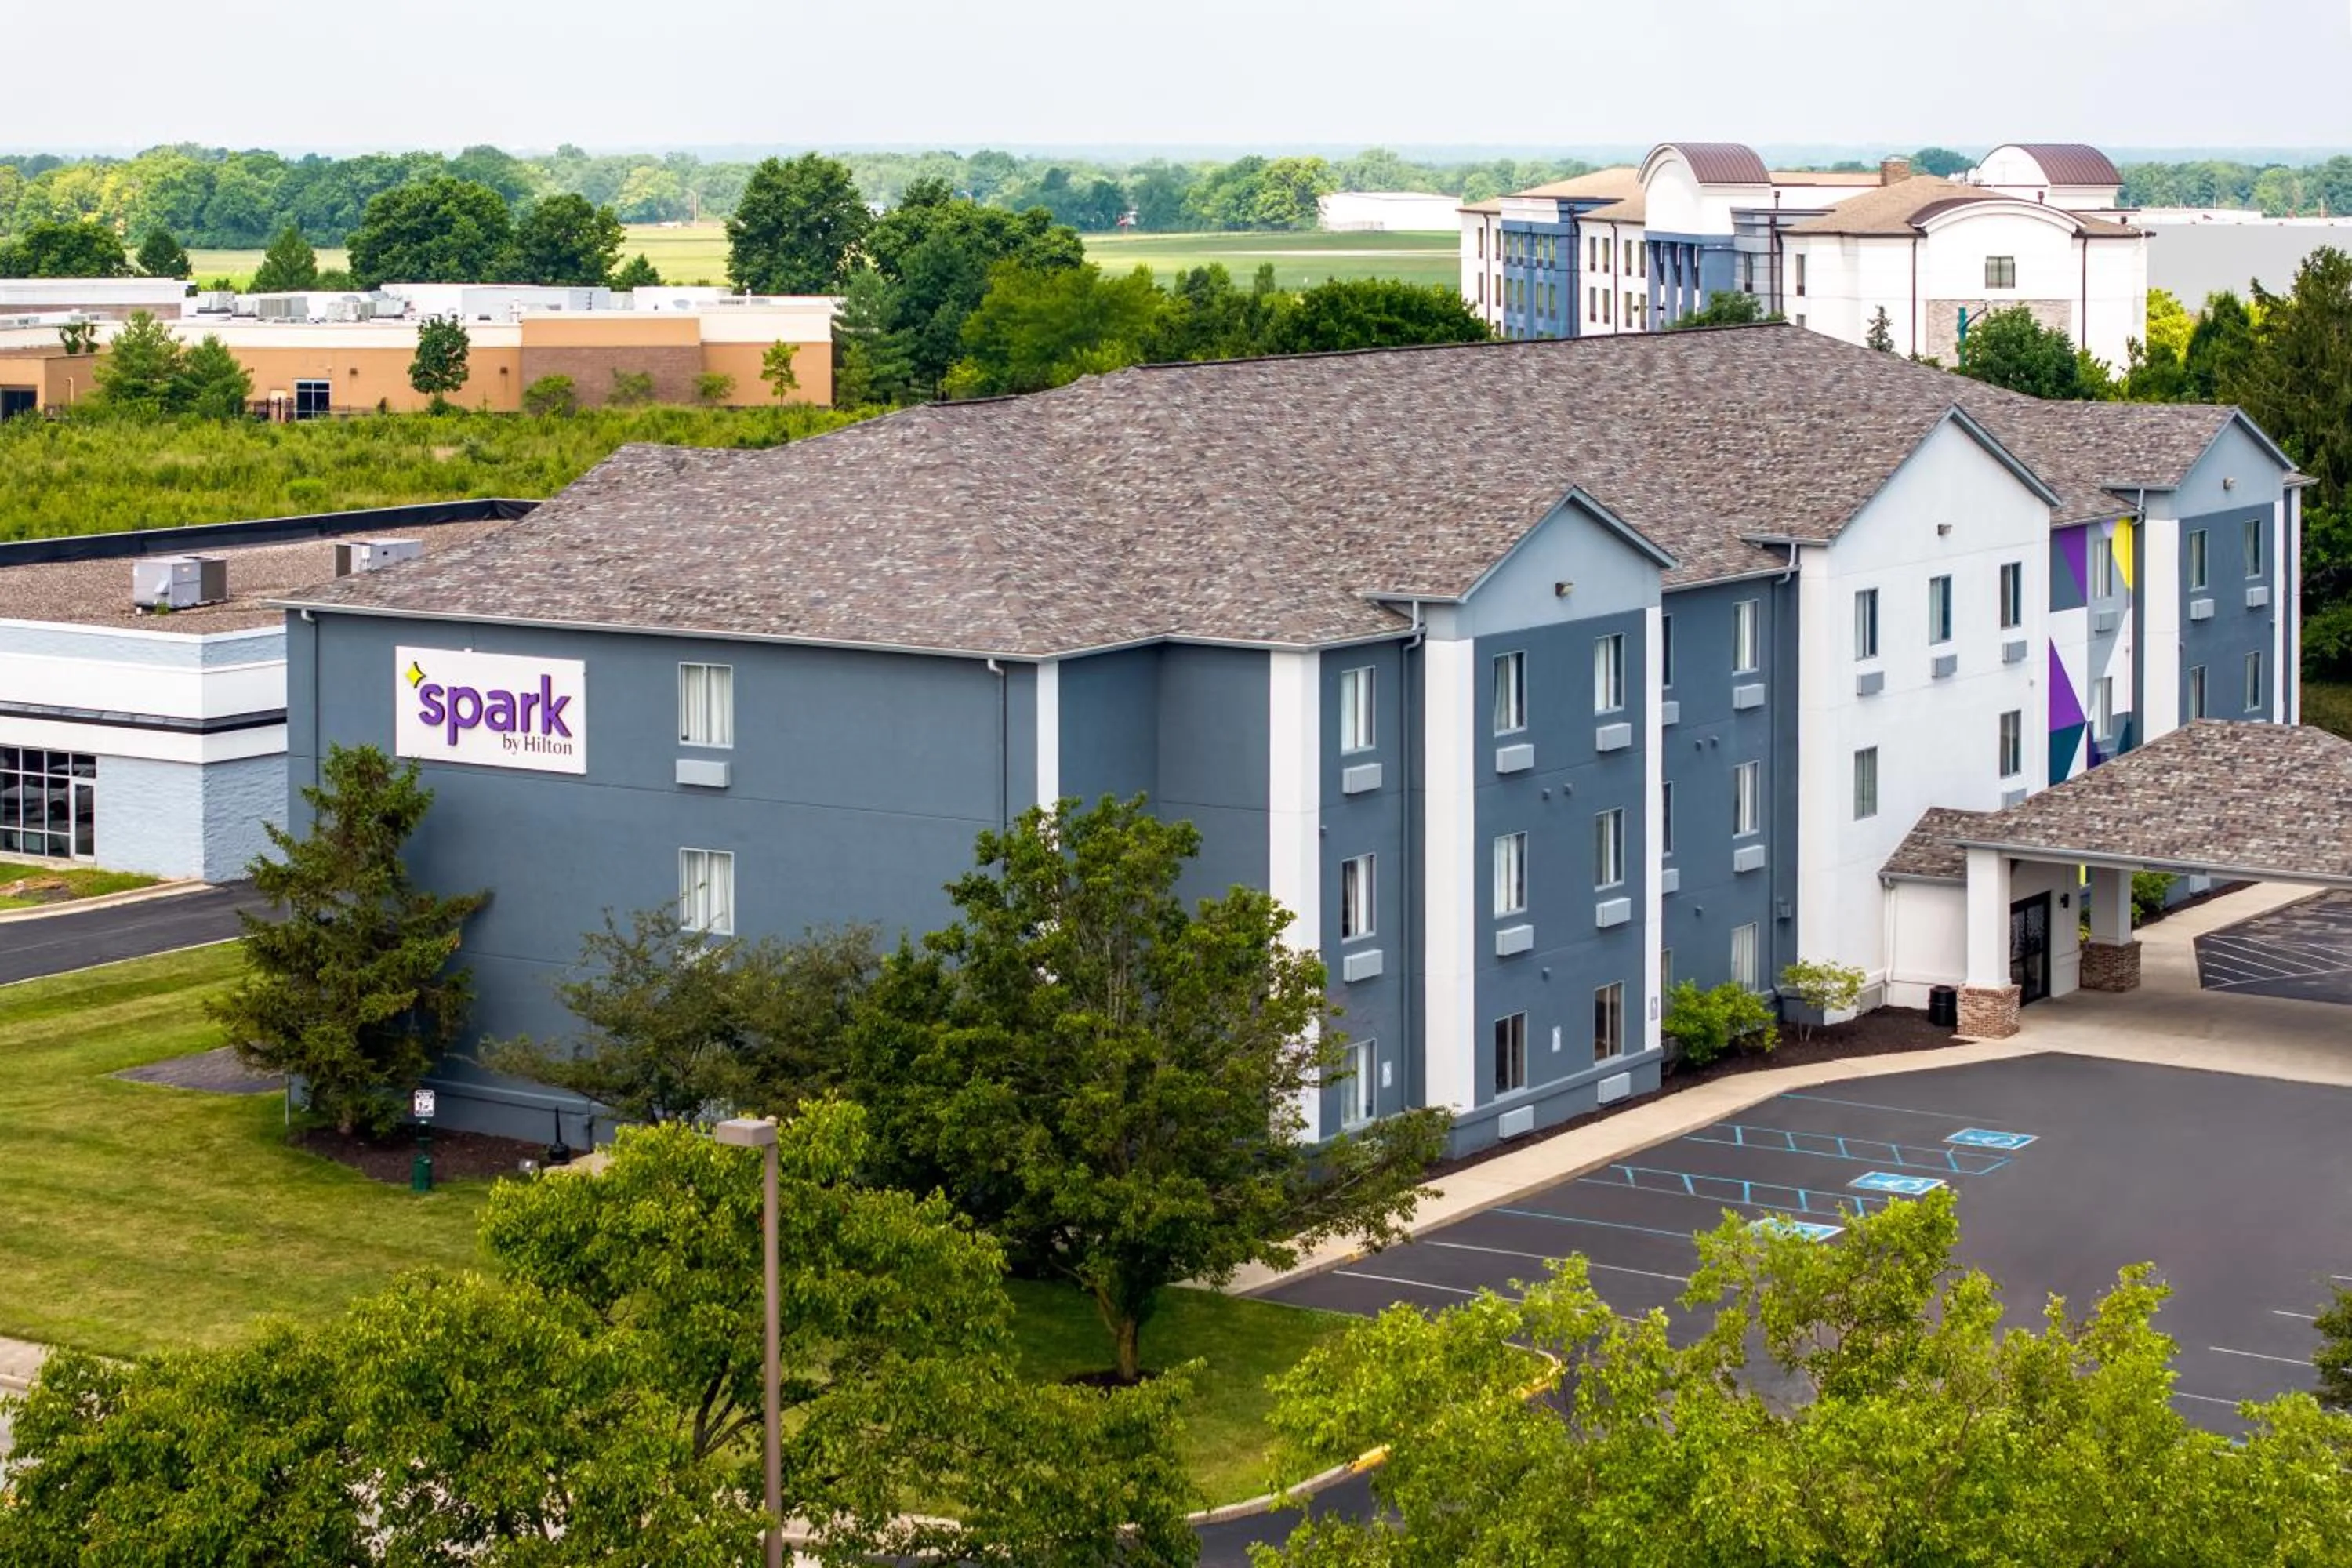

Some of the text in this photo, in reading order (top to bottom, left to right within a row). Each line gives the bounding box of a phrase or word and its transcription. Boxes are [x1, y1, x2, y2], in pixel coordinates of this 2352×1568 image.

[419, 674, 572, 746] spark
[503, 733, 572, 755] by Hilton
